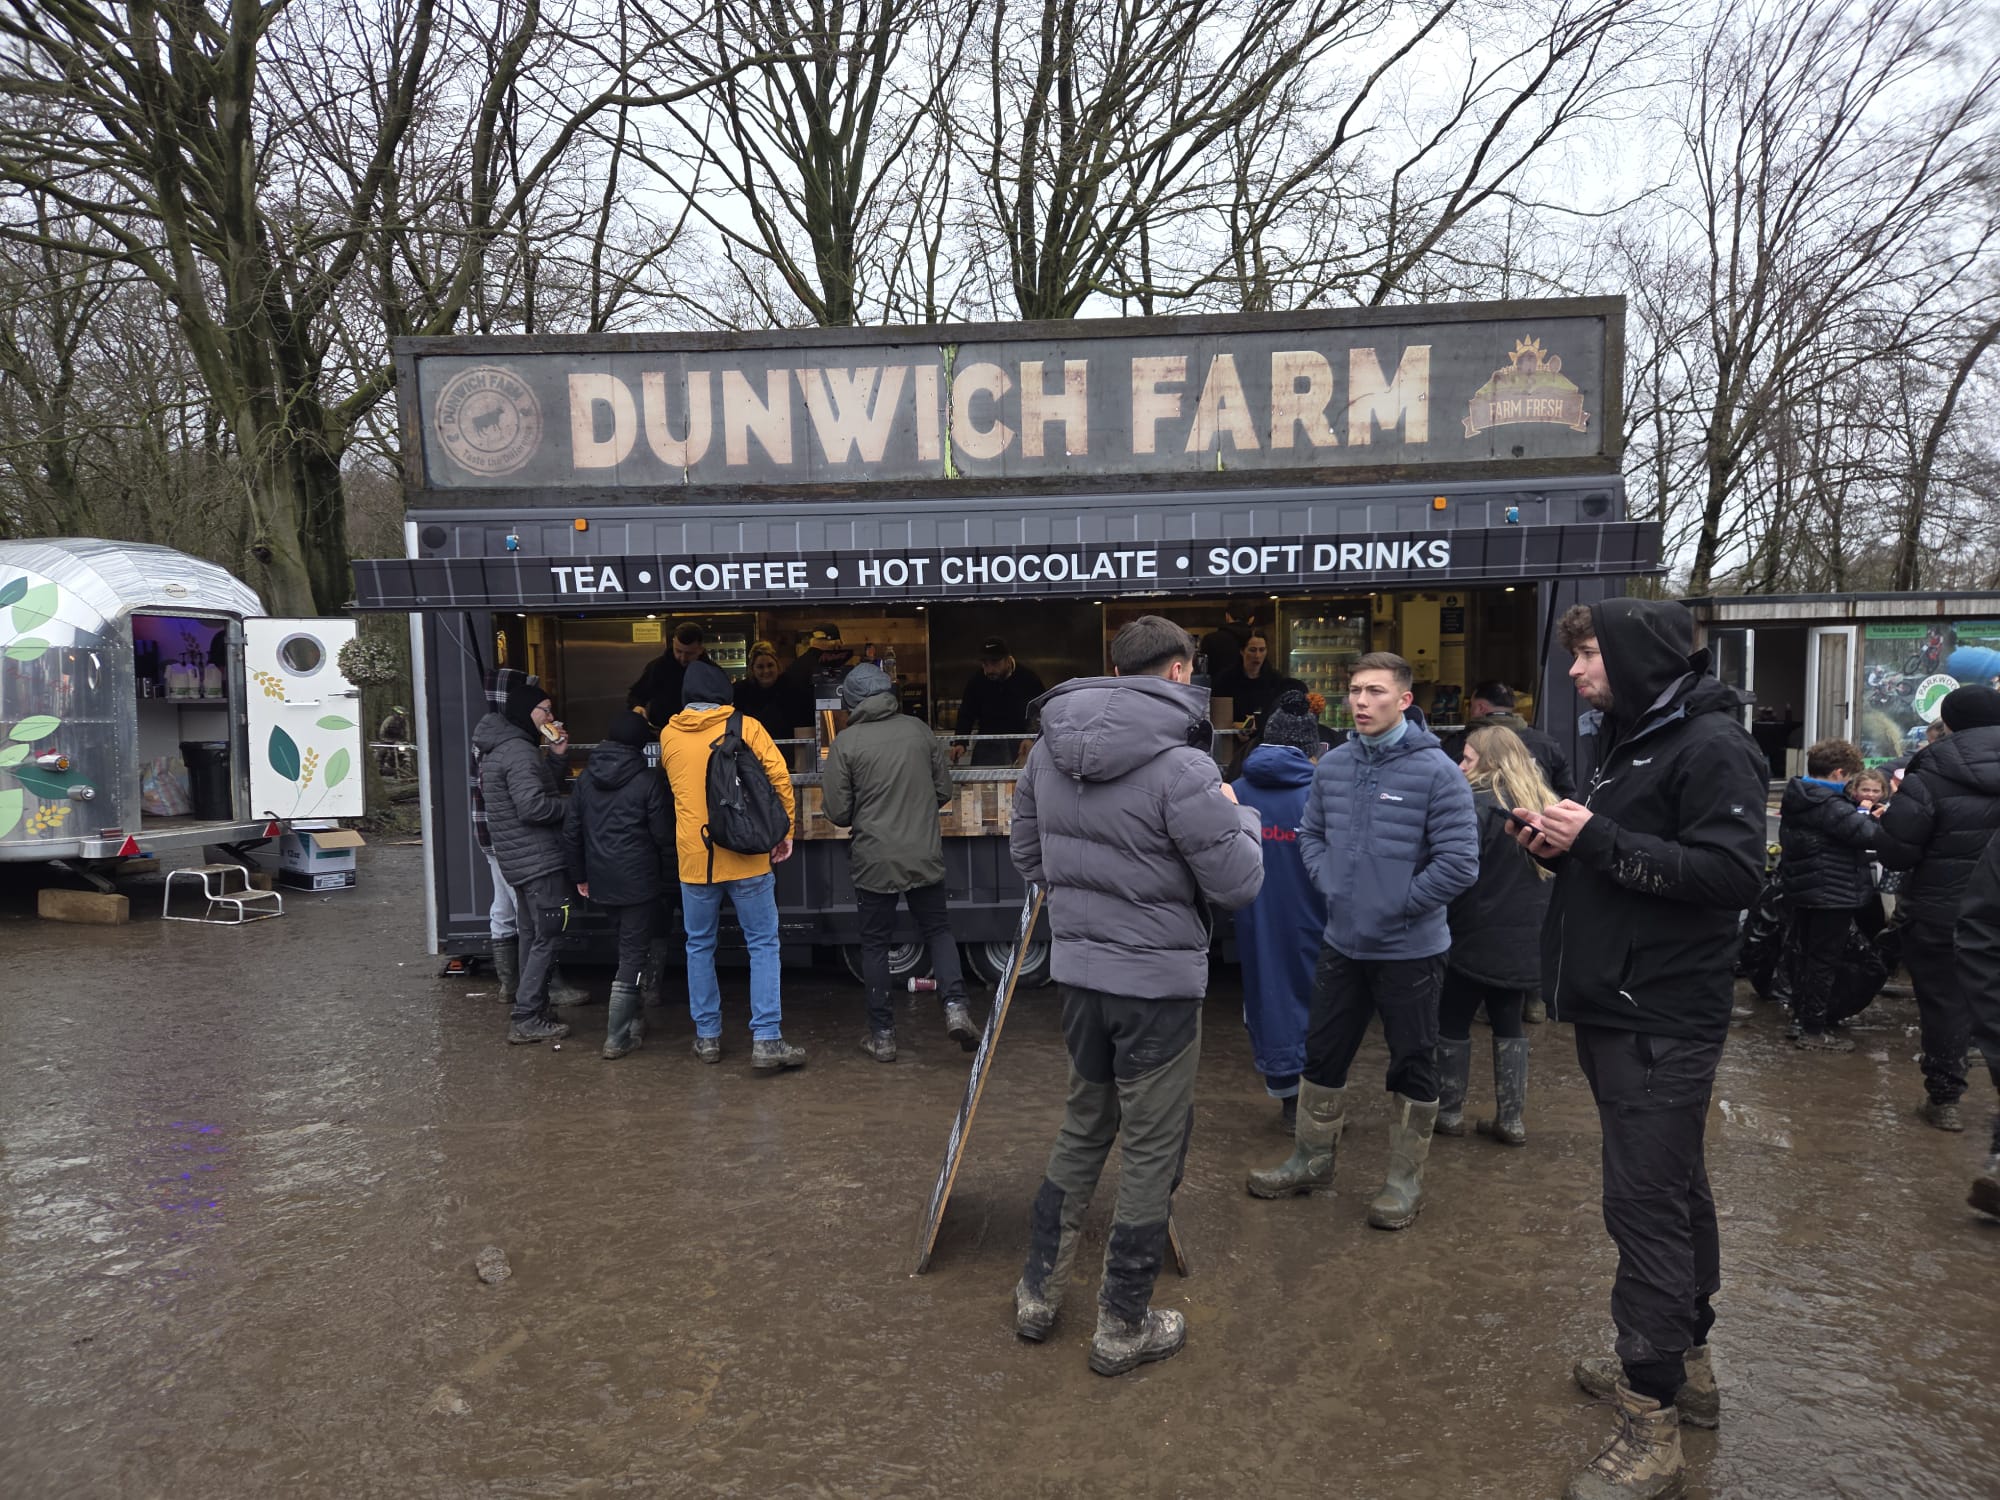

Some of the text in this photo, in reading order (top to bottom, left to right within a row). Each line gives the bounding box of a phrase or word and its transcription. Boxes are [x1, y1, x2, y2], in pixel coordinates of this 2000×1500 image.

[443, 375, 487, 424] DUNWICH
[568, 345, 1432, 469] DUNWICH FARM
[1489, 399, 1564, 420] FARM FRESH
[551, 540, 1450, 593] TEA COFFEE HOT CHOCOLATE SOFT DRINKS
[1918, 675, 1959, 696] PARKWOO
